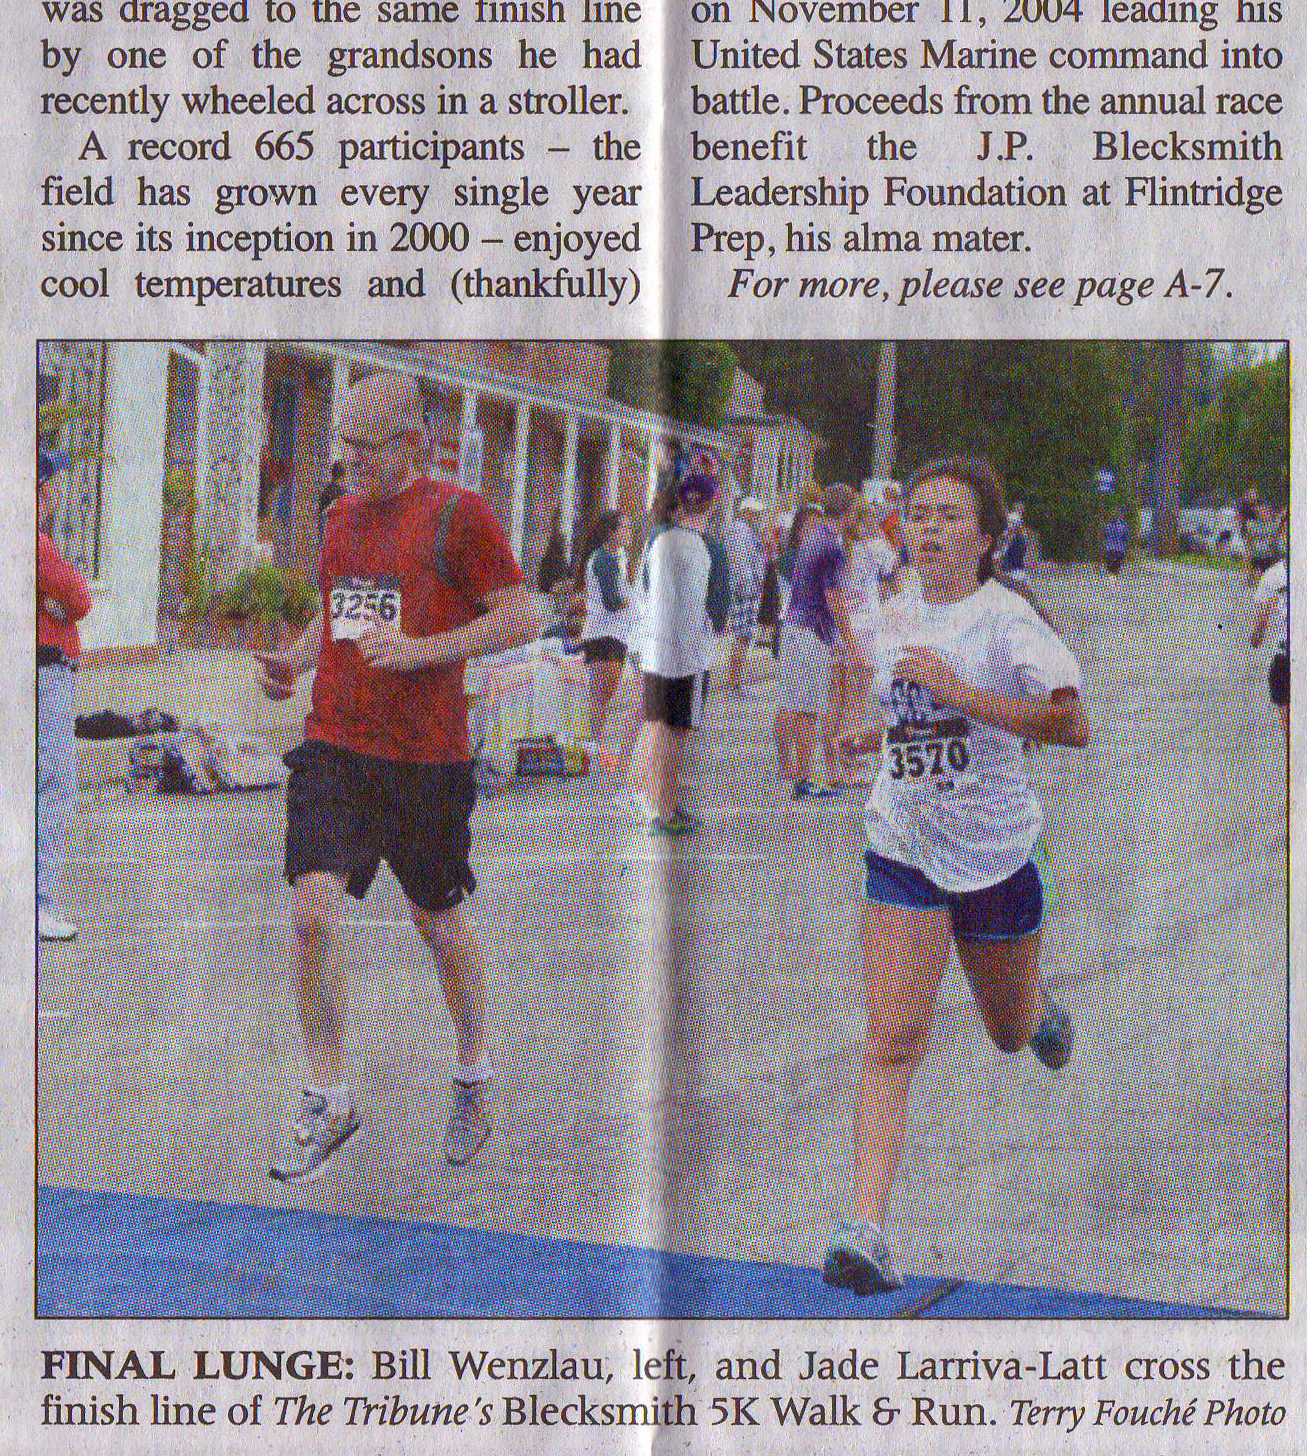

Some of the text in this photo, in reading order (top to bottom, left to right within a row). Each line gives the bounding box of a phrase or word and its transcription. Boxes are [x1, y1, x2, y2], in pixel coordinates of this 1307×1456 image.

[690, 1, 732, 24] on
[727, 267, 1233, 307] For more, please see page A-7.
[330, 591, 397, 621] 3256
[890, 739, 970, 781] 3570
[40, 1347, 1286, 1385] FINAL LUNGE: Bill Wenzlau, left, and Jade Larriva-Latt cross the
[40, 1391, 1287, 1434] finish line of The Tribune's Blecksmith 5K Walk & Run. Terry Fouché Photo
